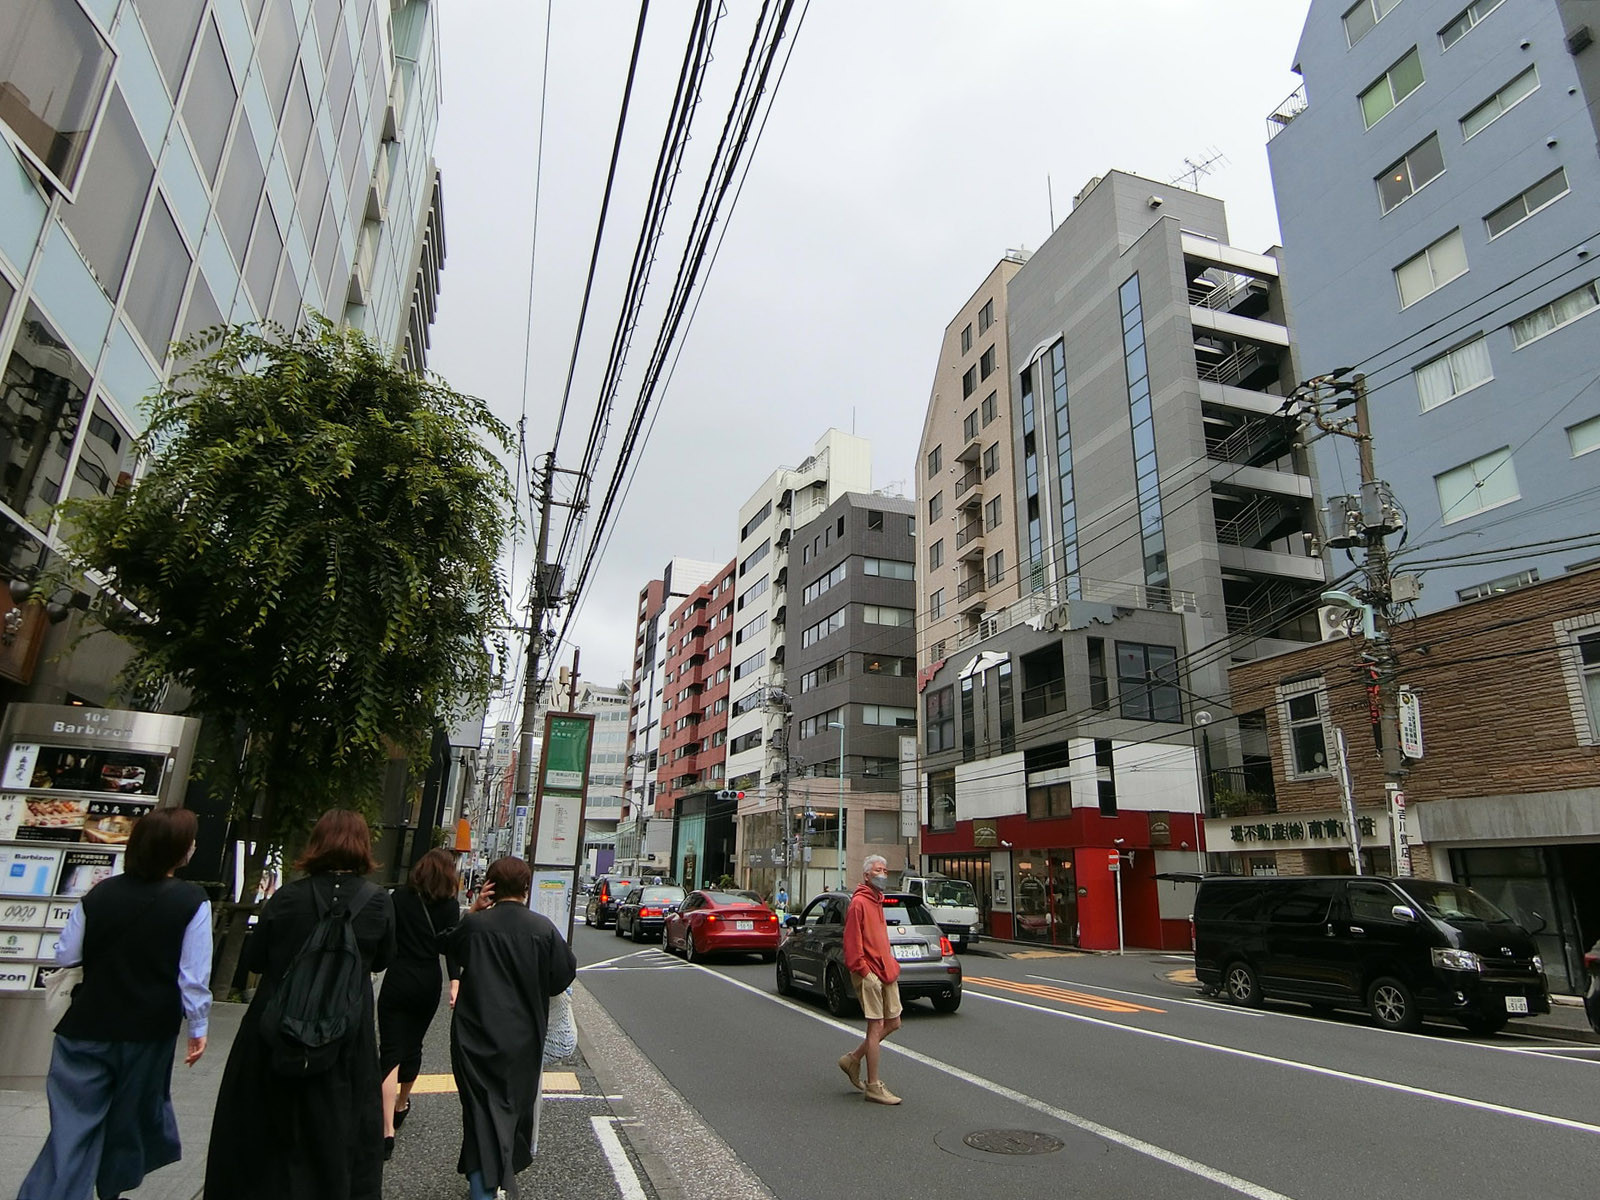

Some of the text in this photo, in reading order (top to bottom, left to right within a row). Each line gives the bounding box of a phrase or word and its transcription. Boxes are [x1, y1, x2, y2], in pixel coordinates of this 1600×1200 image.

[84, 712, 110, 722] 104
[53, 721, 134, 737] Barbizon
[90, 804, 121, 814] 焼き鳥
[14, 853, 54, 861] Barbizon
